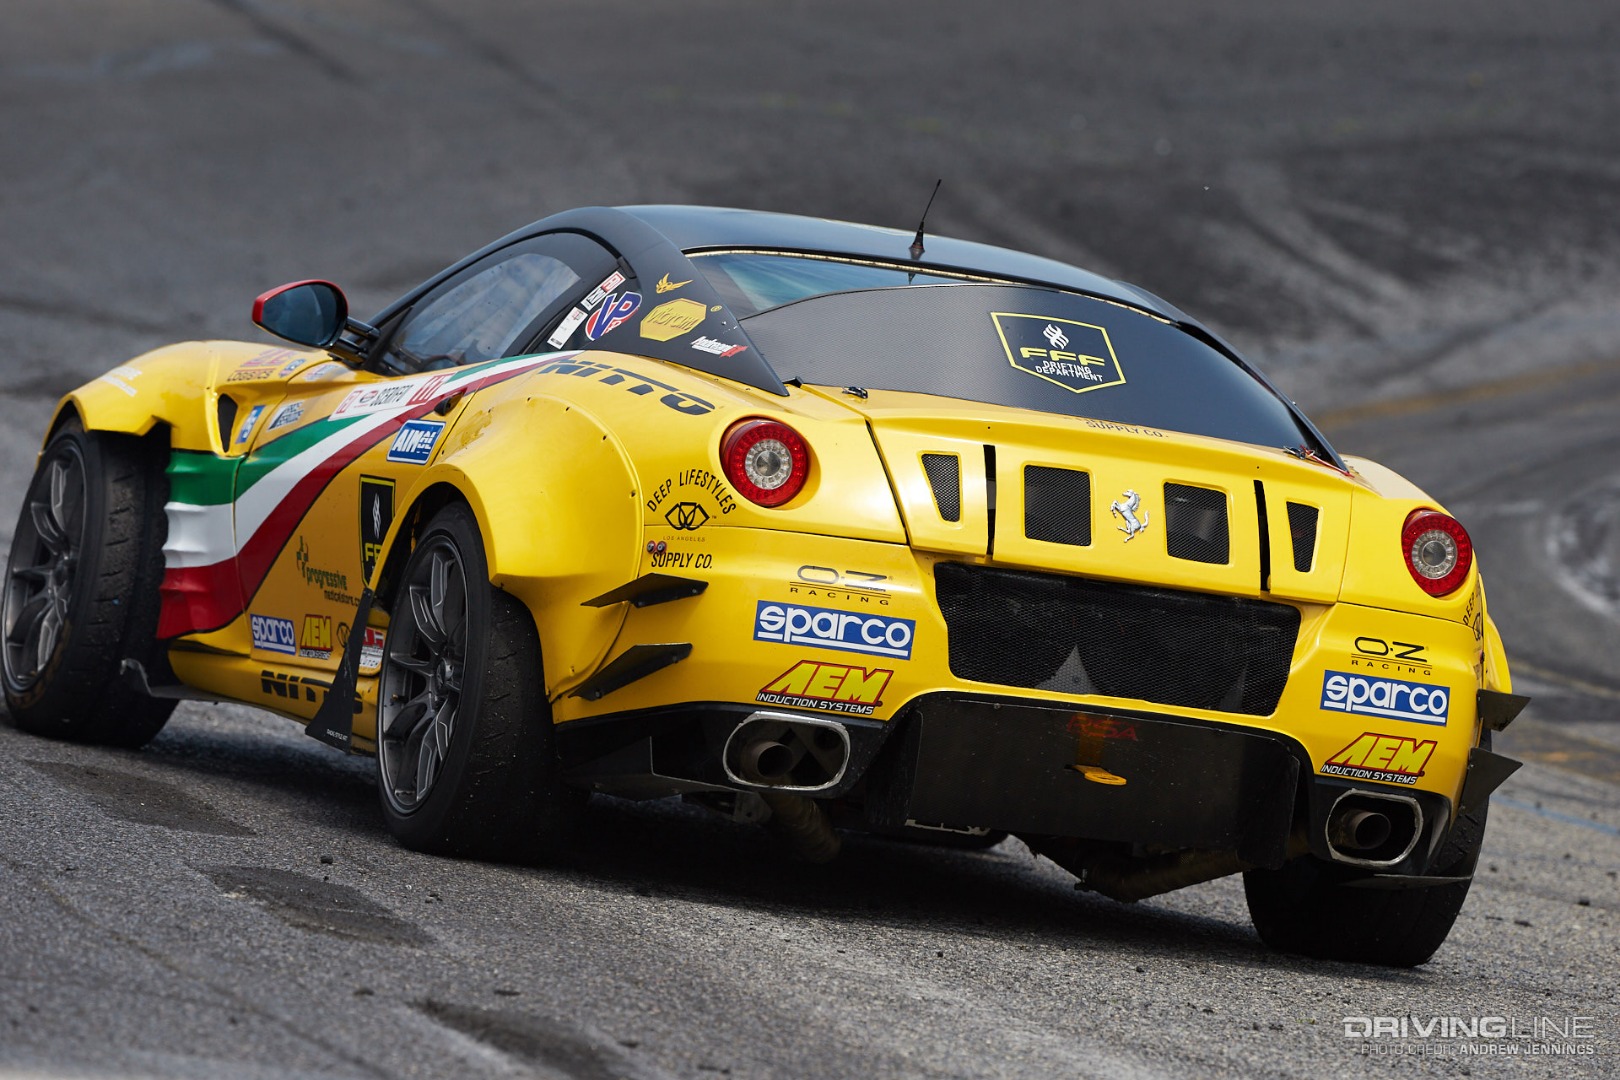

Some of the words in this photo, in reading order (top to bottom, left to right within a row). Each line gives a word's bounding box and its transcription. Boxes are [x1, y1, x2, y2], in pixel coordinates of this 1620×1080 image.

[590, 291, 643, 341] VP
[1019, 347, 1105, 367] FFF
[1043, 360, 1092, 374] DRIFTING
[537, 358, 716, 416] NITTO
[1035, 365, 1103, 382] DEPARTMENT
[1085, 420, 1140, 434] SUPPLY
[647, 478, 672, 512] DEEP
[679, 468, 737, 515] LIFESTYLES
[651, 551, 694, 568] SUPPLY
[695, 553, 713, 569] CO.
[306, 566, 348, 591] progressive
[790, 587, 889, 606] RACING
[1462, 592, 1475, 626] DEEP
[252, 616, 295, 648] sparco
[300, 613, 333, 651] AEM
[759, 605, 912, 648] sparco
[1351, 659, 1431, 676] RACING
[760, 660, 893, 706] AEM
[1326, 675, 1448, 715] sparco
[757, 692, 819, 708] INDUCTION
[819, 700, 874, 715] SYSTEMS
[1325, 732, 1438, 776] AEM
[1321, 764, 1375, 779] INDUCTION
[1374, 771, 1417, 784] SYSTEMS
